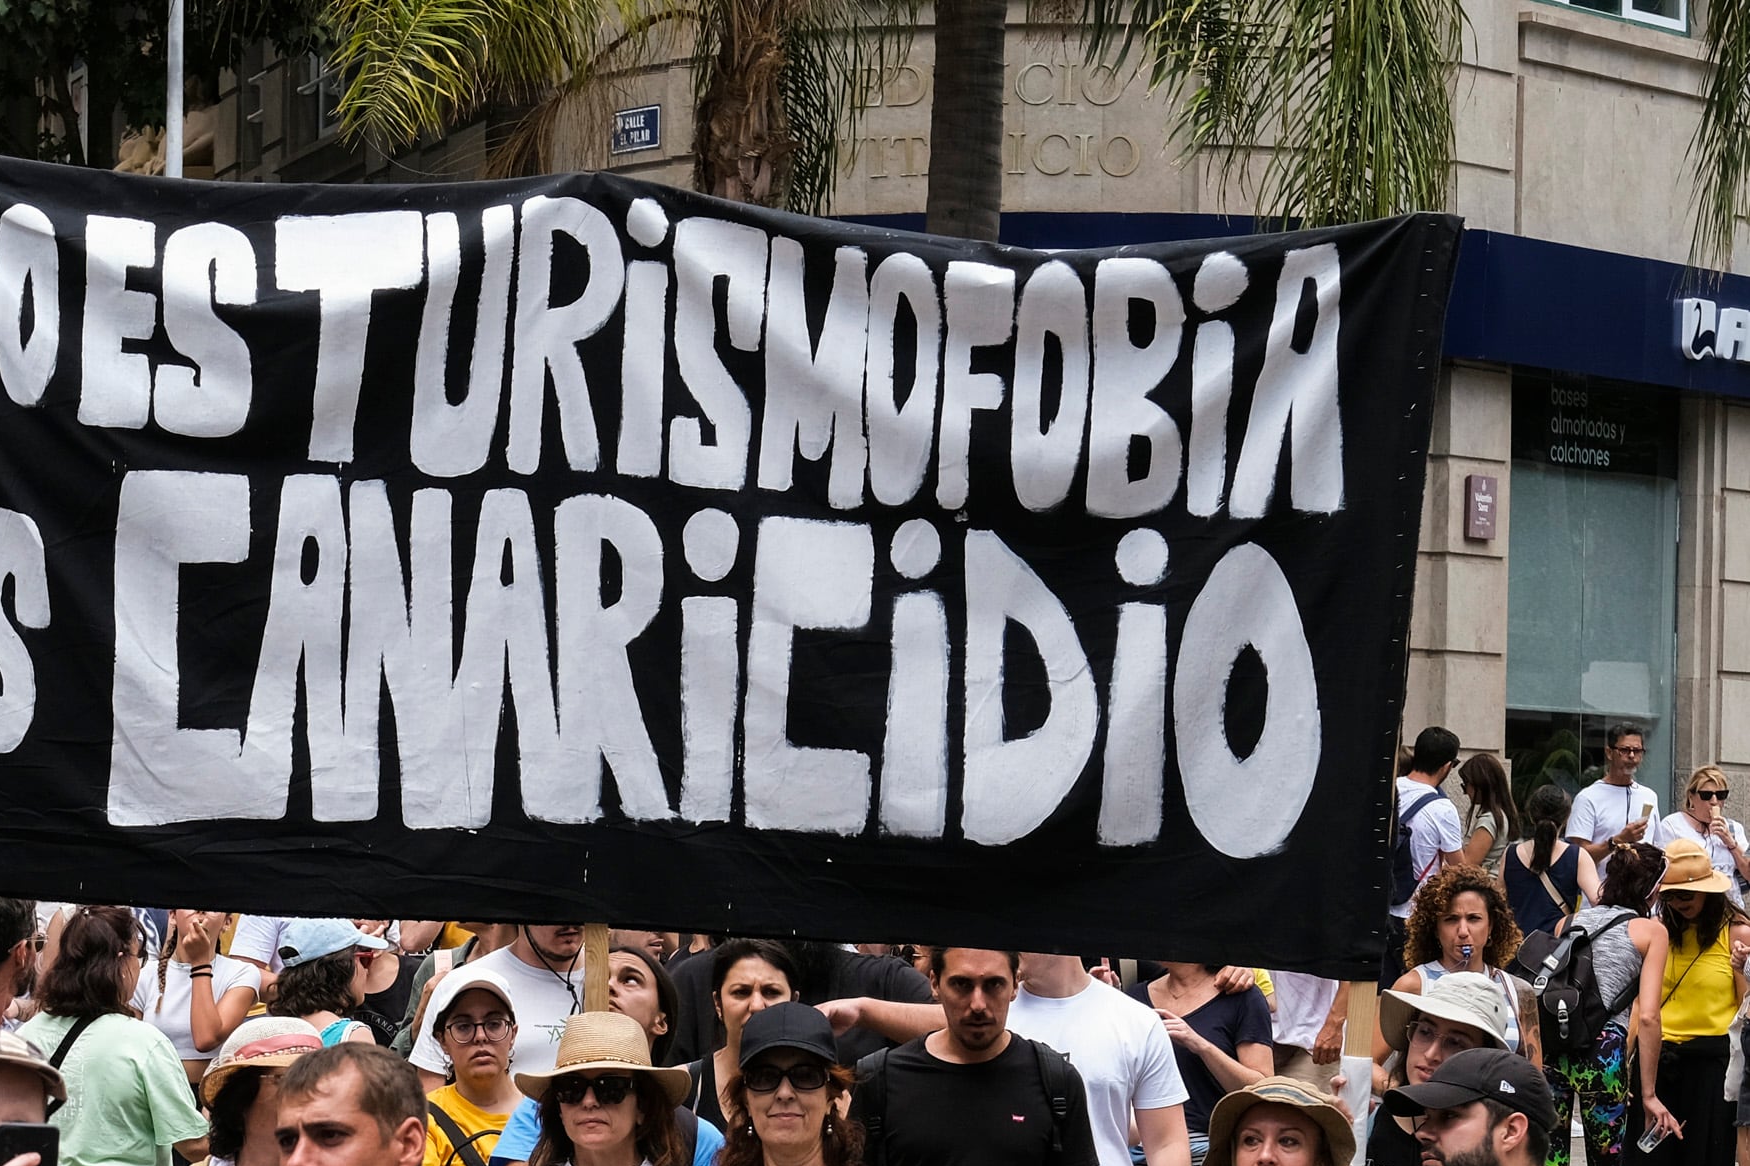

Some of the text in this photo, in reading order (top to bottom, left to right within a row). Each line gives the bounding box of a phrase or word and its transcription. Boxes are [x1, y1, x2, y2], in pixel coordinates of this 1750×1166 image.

[849, 63, 1123, 106] EDCIO
[625, 115, 645, 129] CALLE
[629, 129, 651, 143] PILAR
[840, 132, 1141, 177] VITICIO
[78, 213, 258, 438] ES
[275, 193, 1347, 519] TURiSMOFOBiA
[1551, 384, 1588, 408] bases
[1551, 412, 1626, 445] almohadas y
[1550, 441, 1610, 467] colchones
[106, 470, 1322, 859] CANARiCiDiO
